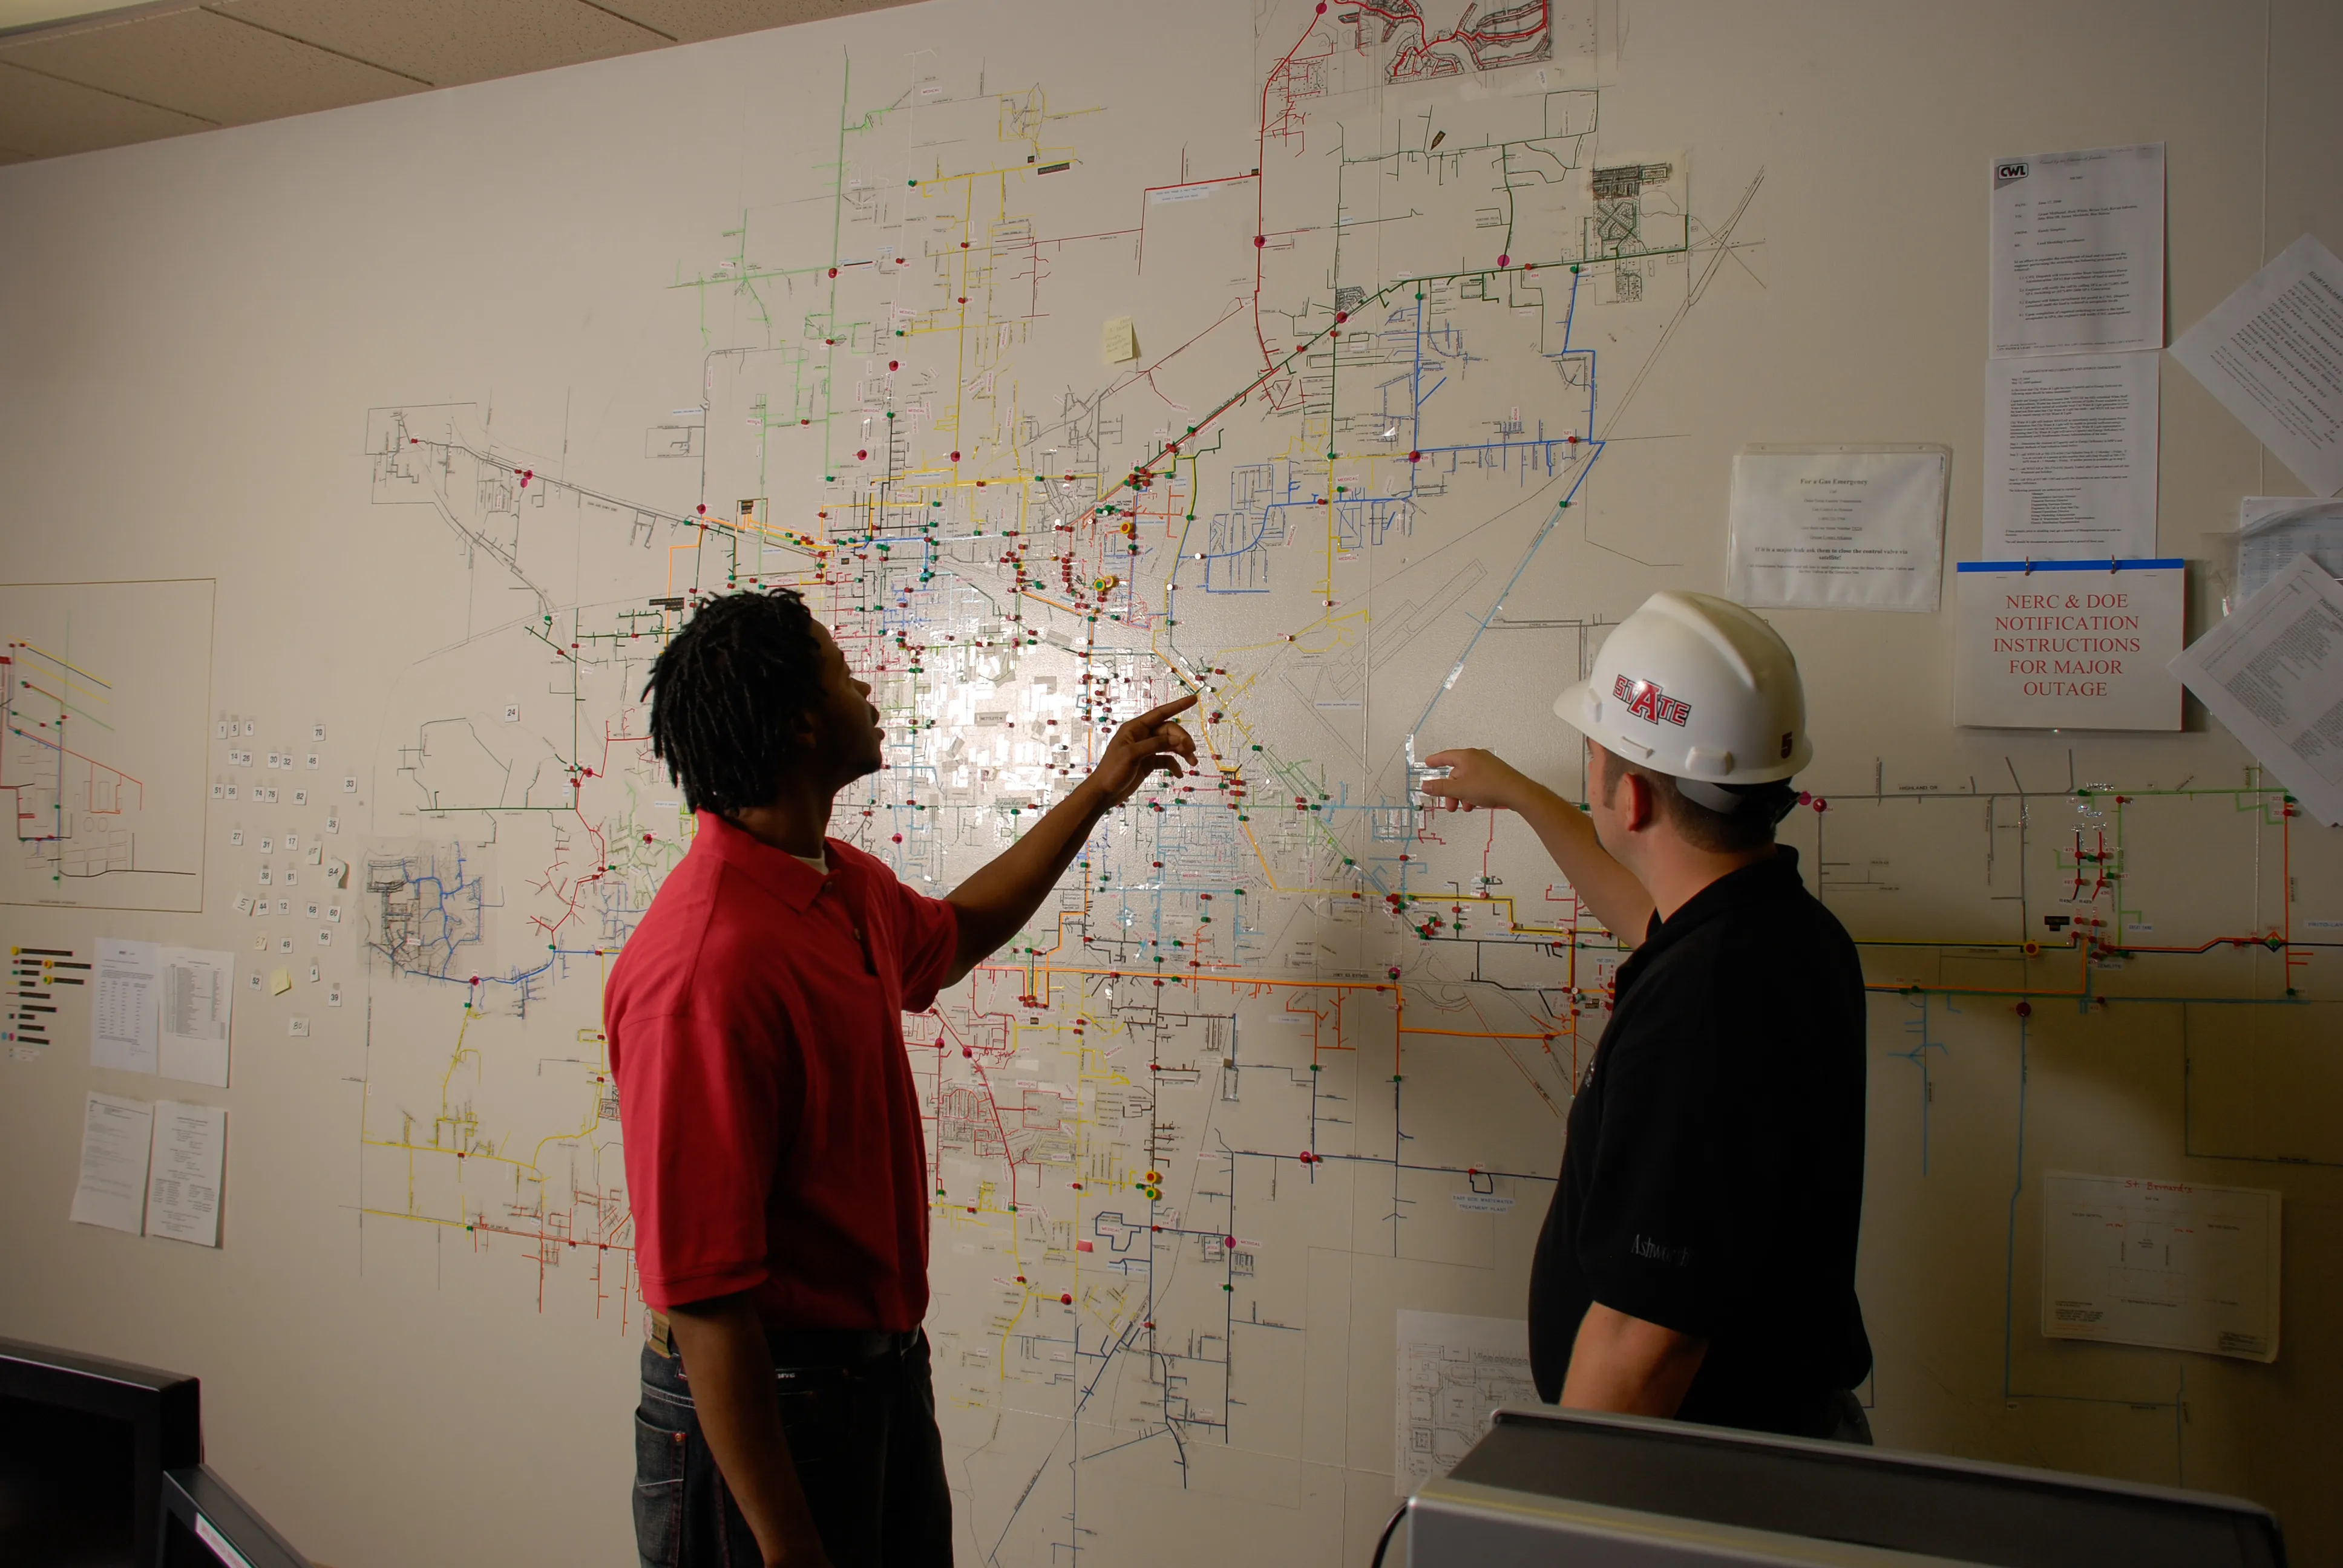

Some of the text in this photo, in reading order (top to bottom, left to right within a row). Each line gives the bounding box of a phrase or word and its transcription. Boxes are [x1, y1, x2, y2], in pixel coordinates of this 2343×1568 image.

[2001, 166, 2026, 177] CWL
[2309, 344, 2332, 366] BREAKER
[1199, 421, 1217, 436] MEDICAL
[2005, 593, 2128, 610] NERC & DOE
[1996, 616, 2138, 631] NOTIFICATION
[1993, 638, 2140, 653] INSTRUCTIONS
[2010, 660, 2122, 675] FOR MAJOR
[2024, 682, 2107, 696] OUTAGE
[1613, 674, 1691, 727] STATE
[507, 708, 516, 717] 24
[2124, 1180, 2194, 1194] St. Bernard's
